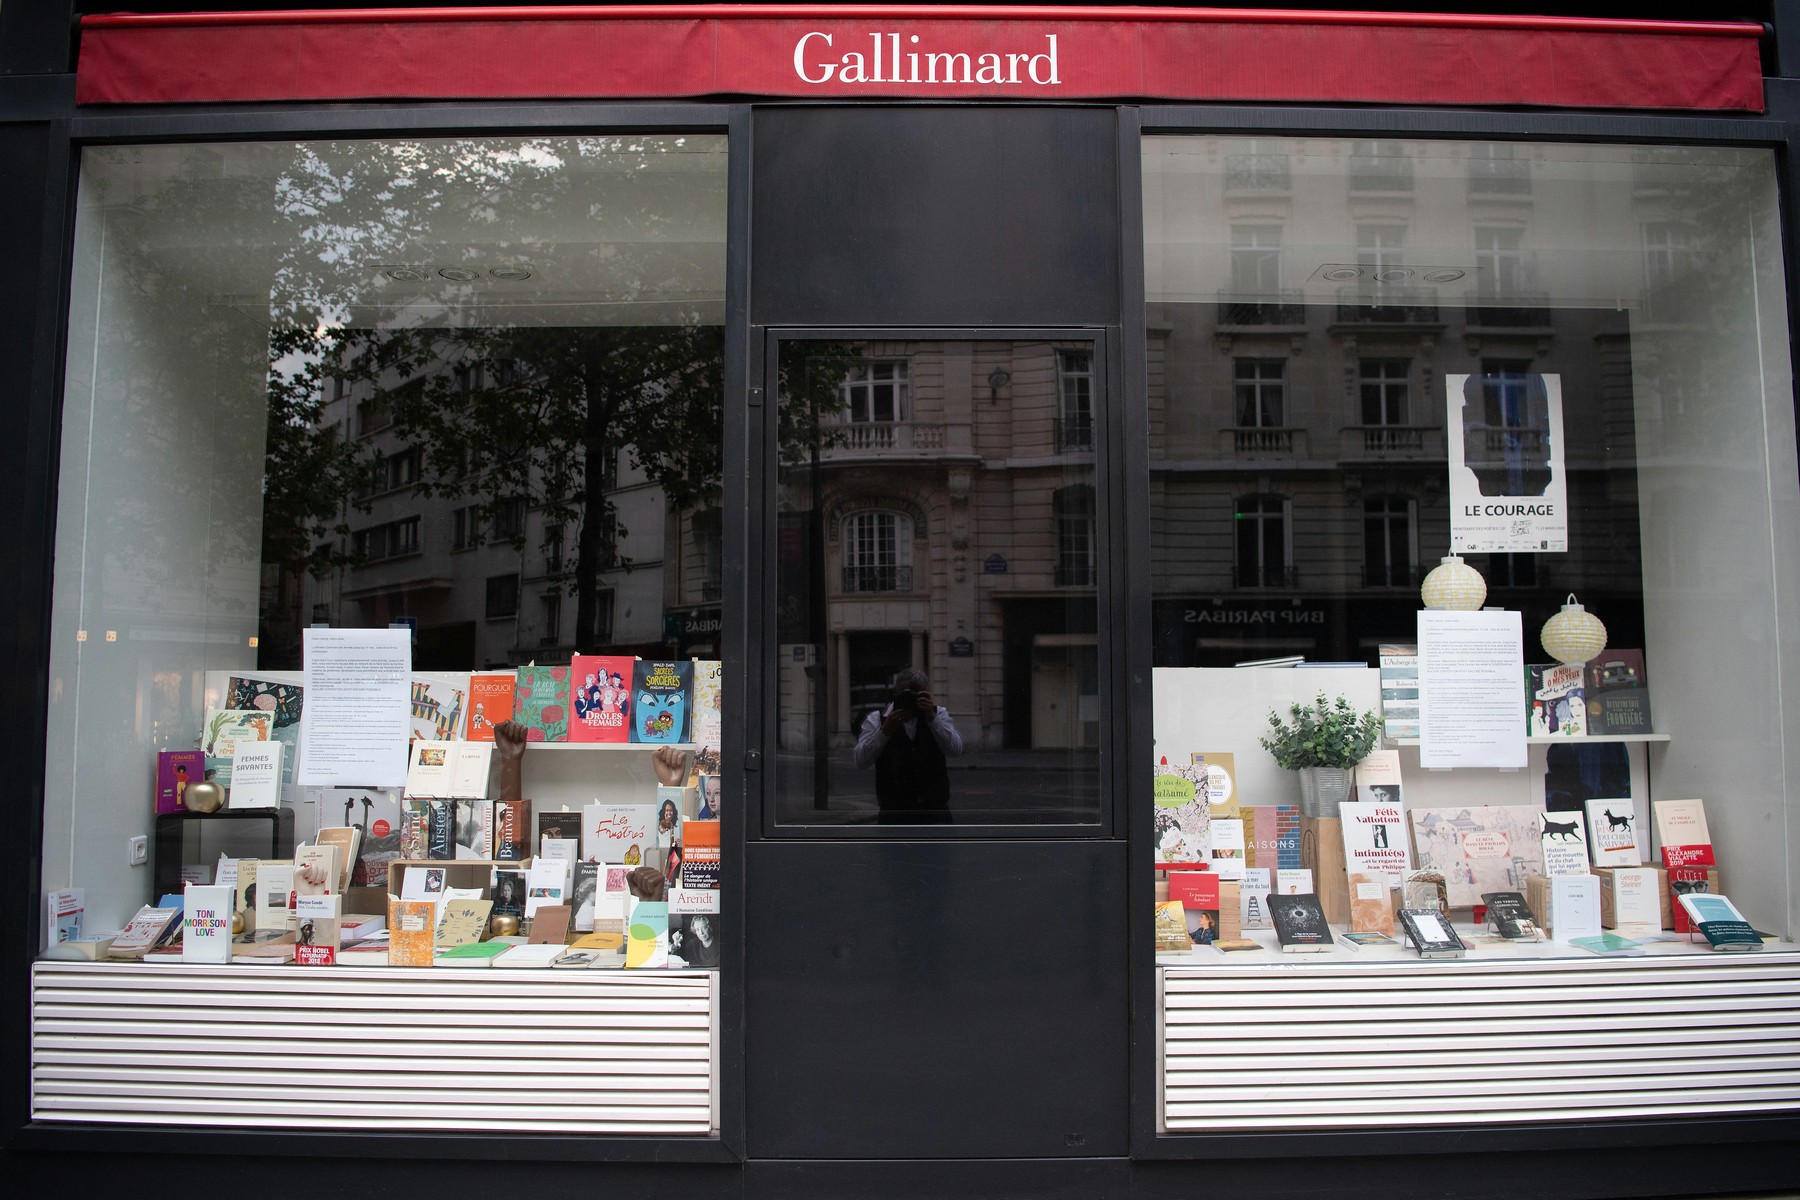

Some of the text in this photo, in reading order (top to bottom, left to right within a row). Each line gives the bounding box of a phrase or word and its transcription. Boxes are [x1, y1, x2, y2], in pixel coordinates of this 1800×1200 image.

[793, 31, 1061, 85] Gallimard
[1465, 505, 1554, 516] LE COURAGE
[646, 675, 680, 687] SORCIÈRES
[586, 711, 622, 720] DRÔLES
[1607, 712, 1644, 726] FRONTIÈRE
[612, 814, 628, 826] Les
[408, 811, 420, 850] Sand
[431, 806, 446, 854] Austen
[481, 806, 492, 856] Yourcenar
[501, 806, 513, 858] Beauvoir
[596, 820, 645, 839] Frustrés
[1248, 840, 1295, 849] AISONS
[1354, 849, 1405, 857] intimité(s)
[1677, 870, 1702, 881] CALET
[677, 893, 713, 903] Arendt
[196, 910, 214, 918] TONI
[184, 919, 226, 928] MORRISON
